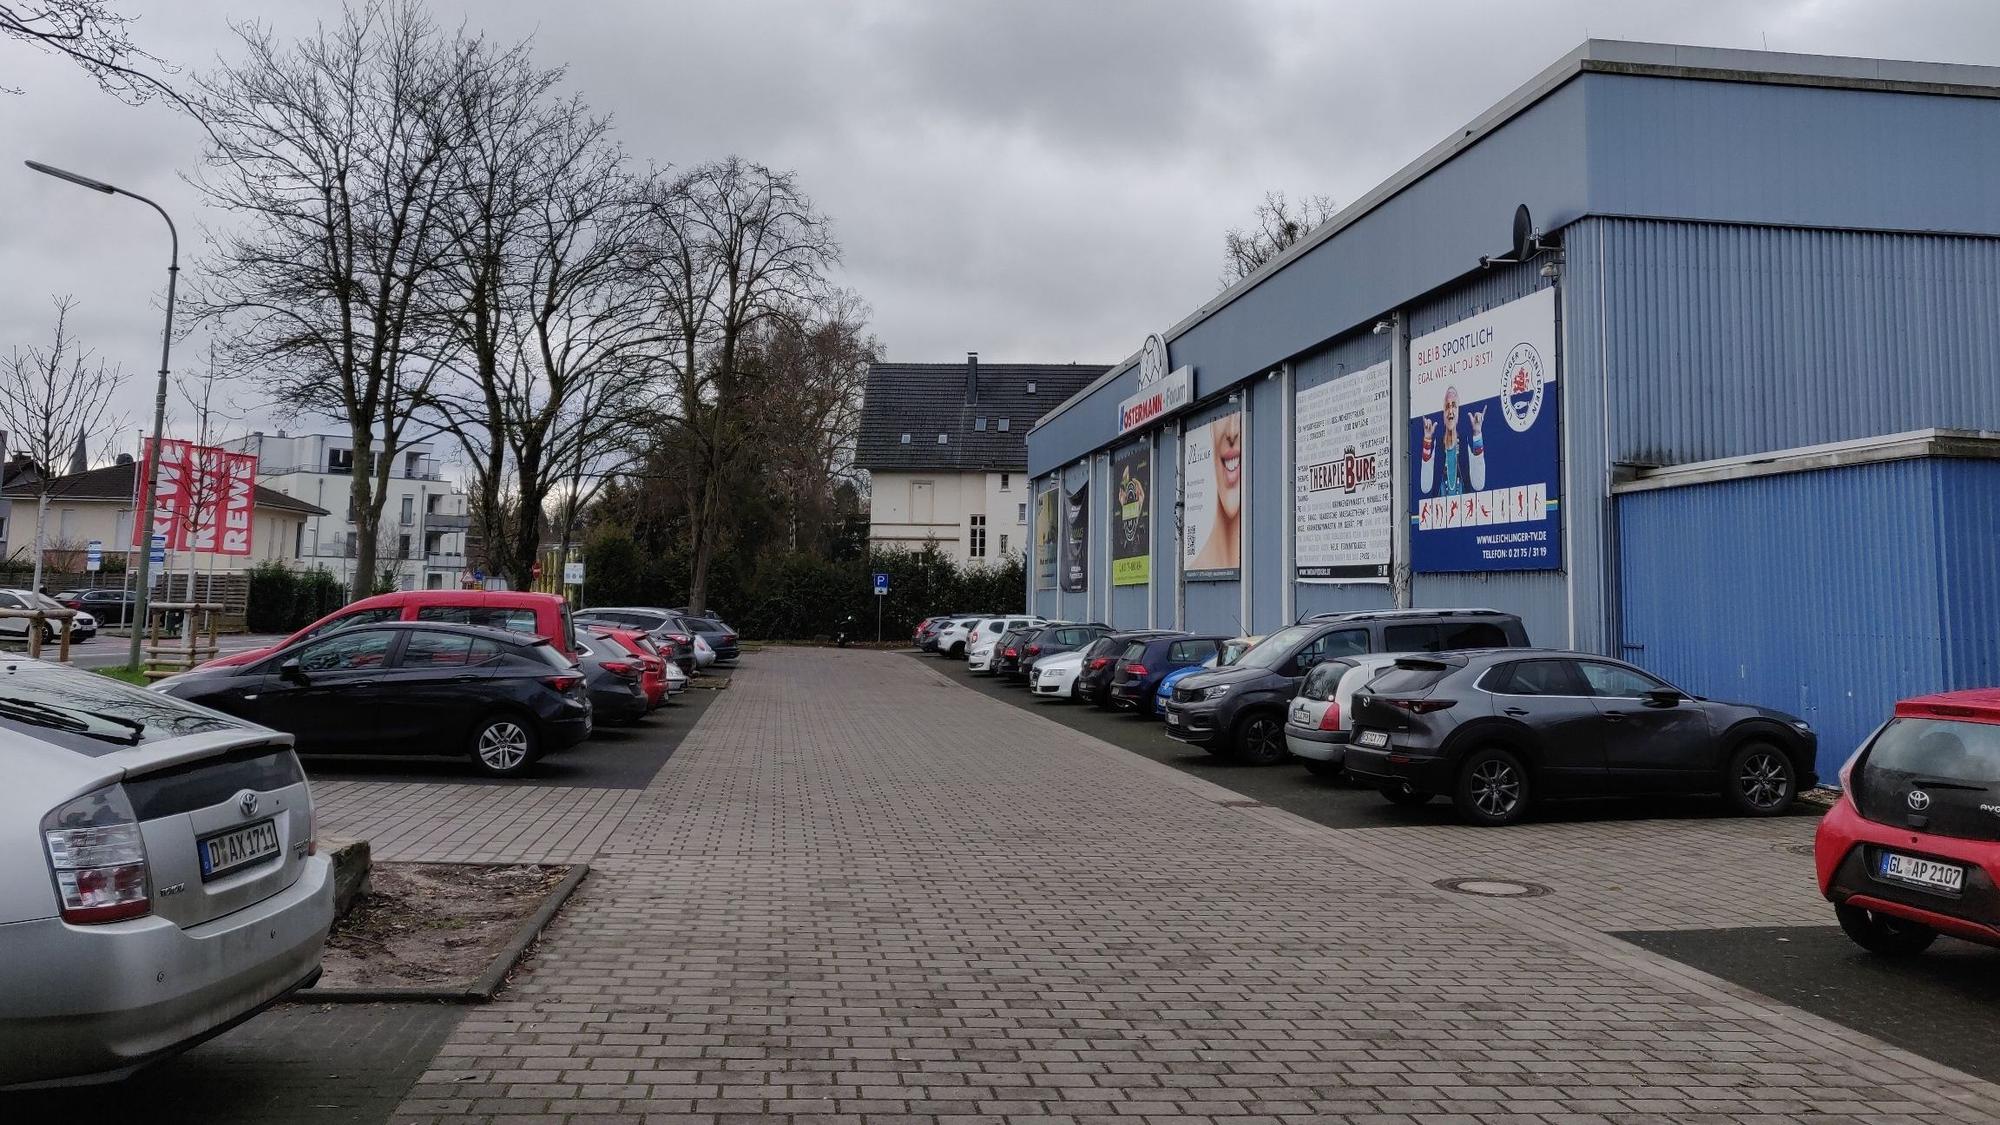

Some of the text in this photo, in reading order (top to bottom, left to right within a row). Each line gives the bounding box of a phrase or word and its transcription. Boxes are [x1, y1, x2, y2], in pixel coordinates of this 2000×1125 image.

[1418, 326, 1493, 366] BLEIB SPORTLICH
[1418, 350, 1493, 385] EGAL WIE ALT DU BIST!
[1503, 349, 1541, 420] LEICHLINGER TURNVEREIN
[222, 458, 252, 551] REWE
[1476, 531, 1547, 545] WWW.LEICHLINGER-TV.DE
[1482, 549, 1508, 559] TELEFON:
[877, 575, 885, 586] P
[209, 841, 220, 868] D
[1888, 856, 1903, 874] GL
[1911, 861, 1928, 879] AP
[1929, 865, 1961, 886] 2107
